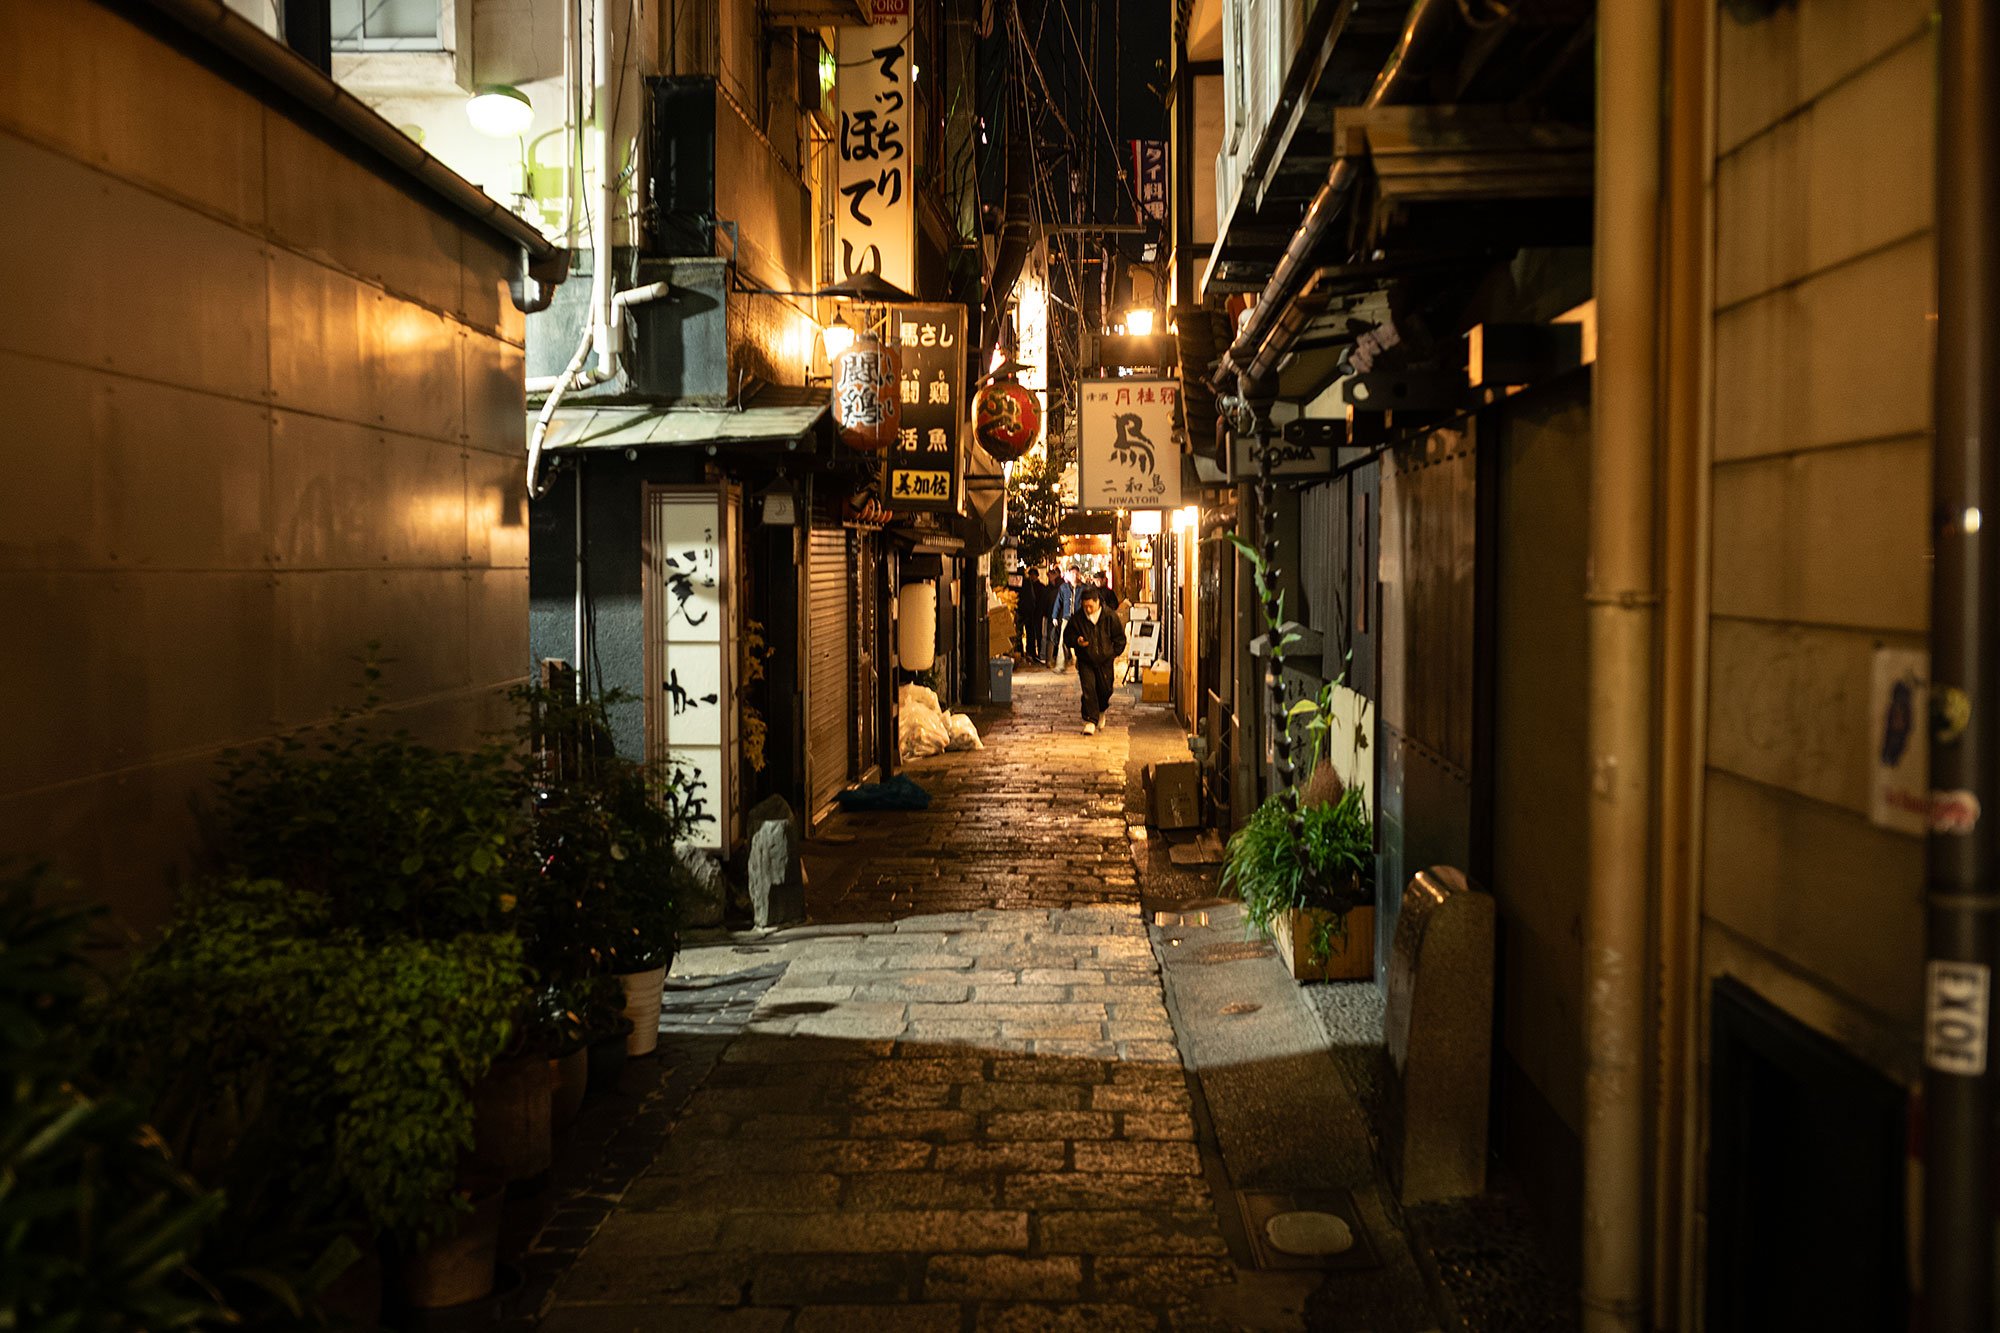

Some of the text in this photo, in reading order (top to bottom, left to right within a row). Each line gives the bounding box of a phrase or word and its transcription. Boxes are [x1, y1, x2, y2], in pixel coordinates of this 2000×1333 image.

[872, 44, 905, 208] てっちり
[840, 110, 882, 281] ほてい
[900, 322, 953, 348] 馬さし
[896, 427, 948, 452] 活魚
[894, 474, 947, 496] 美加佐
[1108, 496, 1159, 505] NIWATORI
